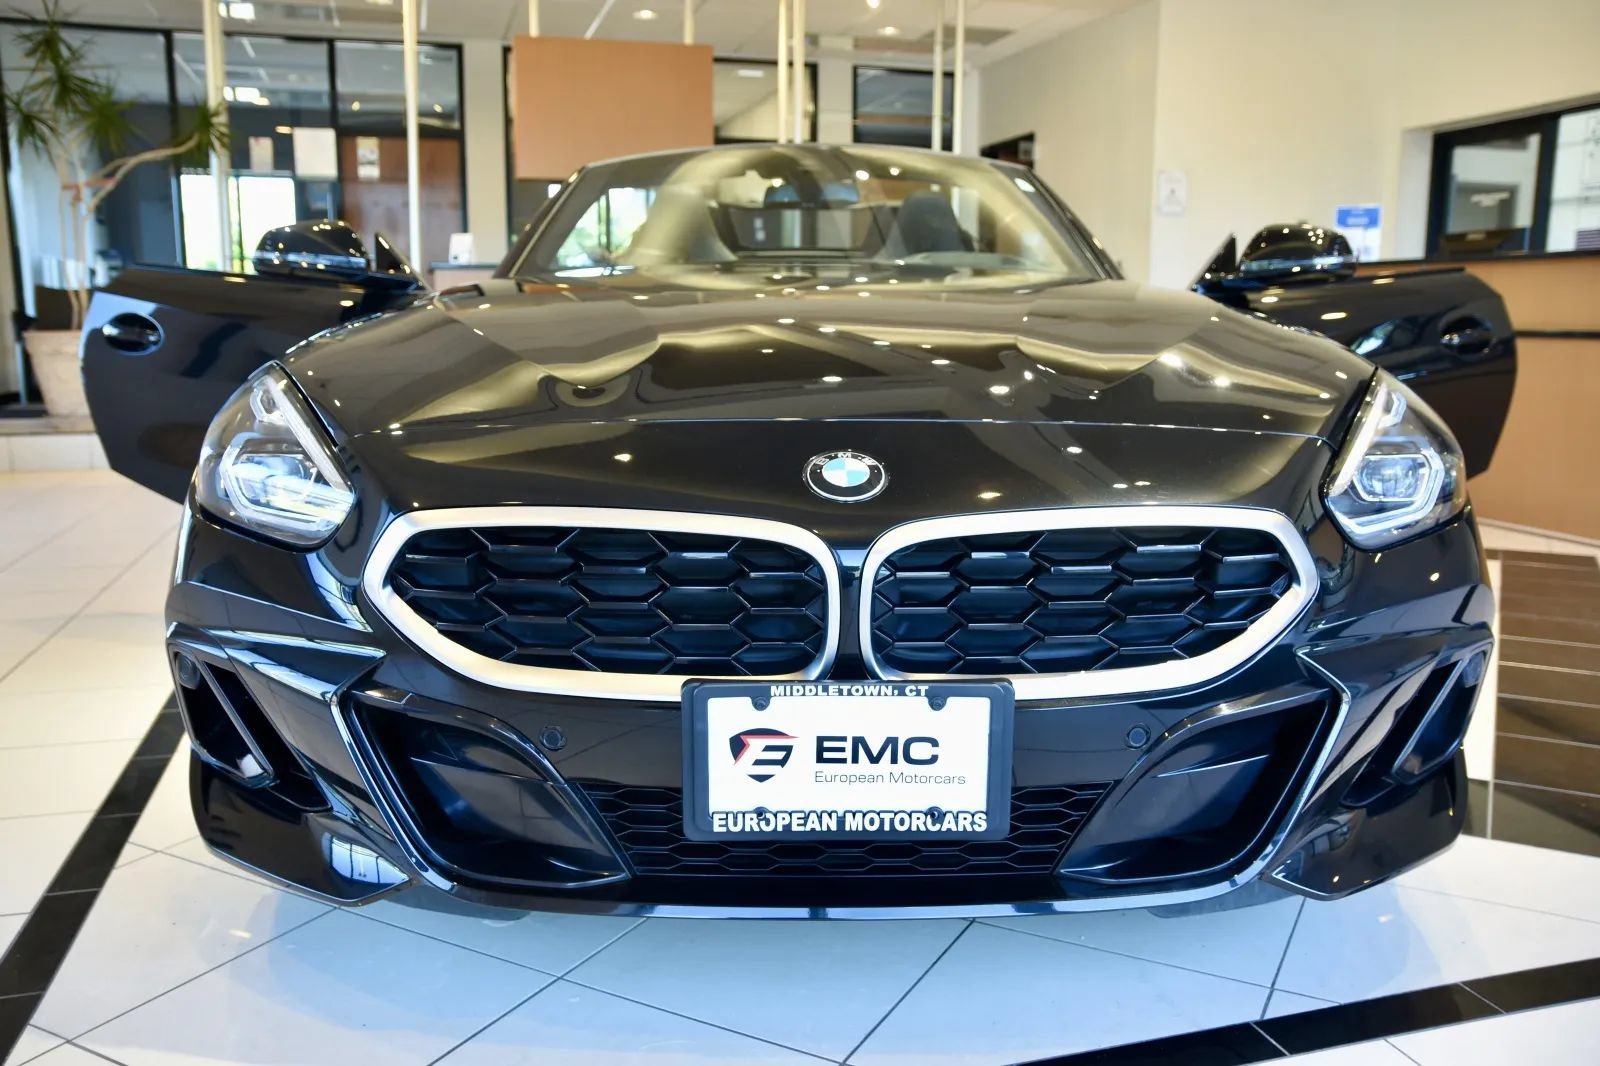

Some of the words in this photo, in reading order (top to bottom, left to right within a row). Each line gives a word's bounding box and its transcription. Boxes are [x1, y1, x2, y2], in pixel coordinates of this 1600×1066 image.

[814, 452, 878, 465] BMW
[769, 685, 898, 697] MIDDLETOWN,
[905, 685, 929, 697] CT
[815, 736, 939, 766] EMC
[815, 771, 884, 785] European
[889, 771, 966, 785] Motorcars
[712, 812, 838, 833] EUROPEAN
[845, 812, 988, 832] MOTORCARS
